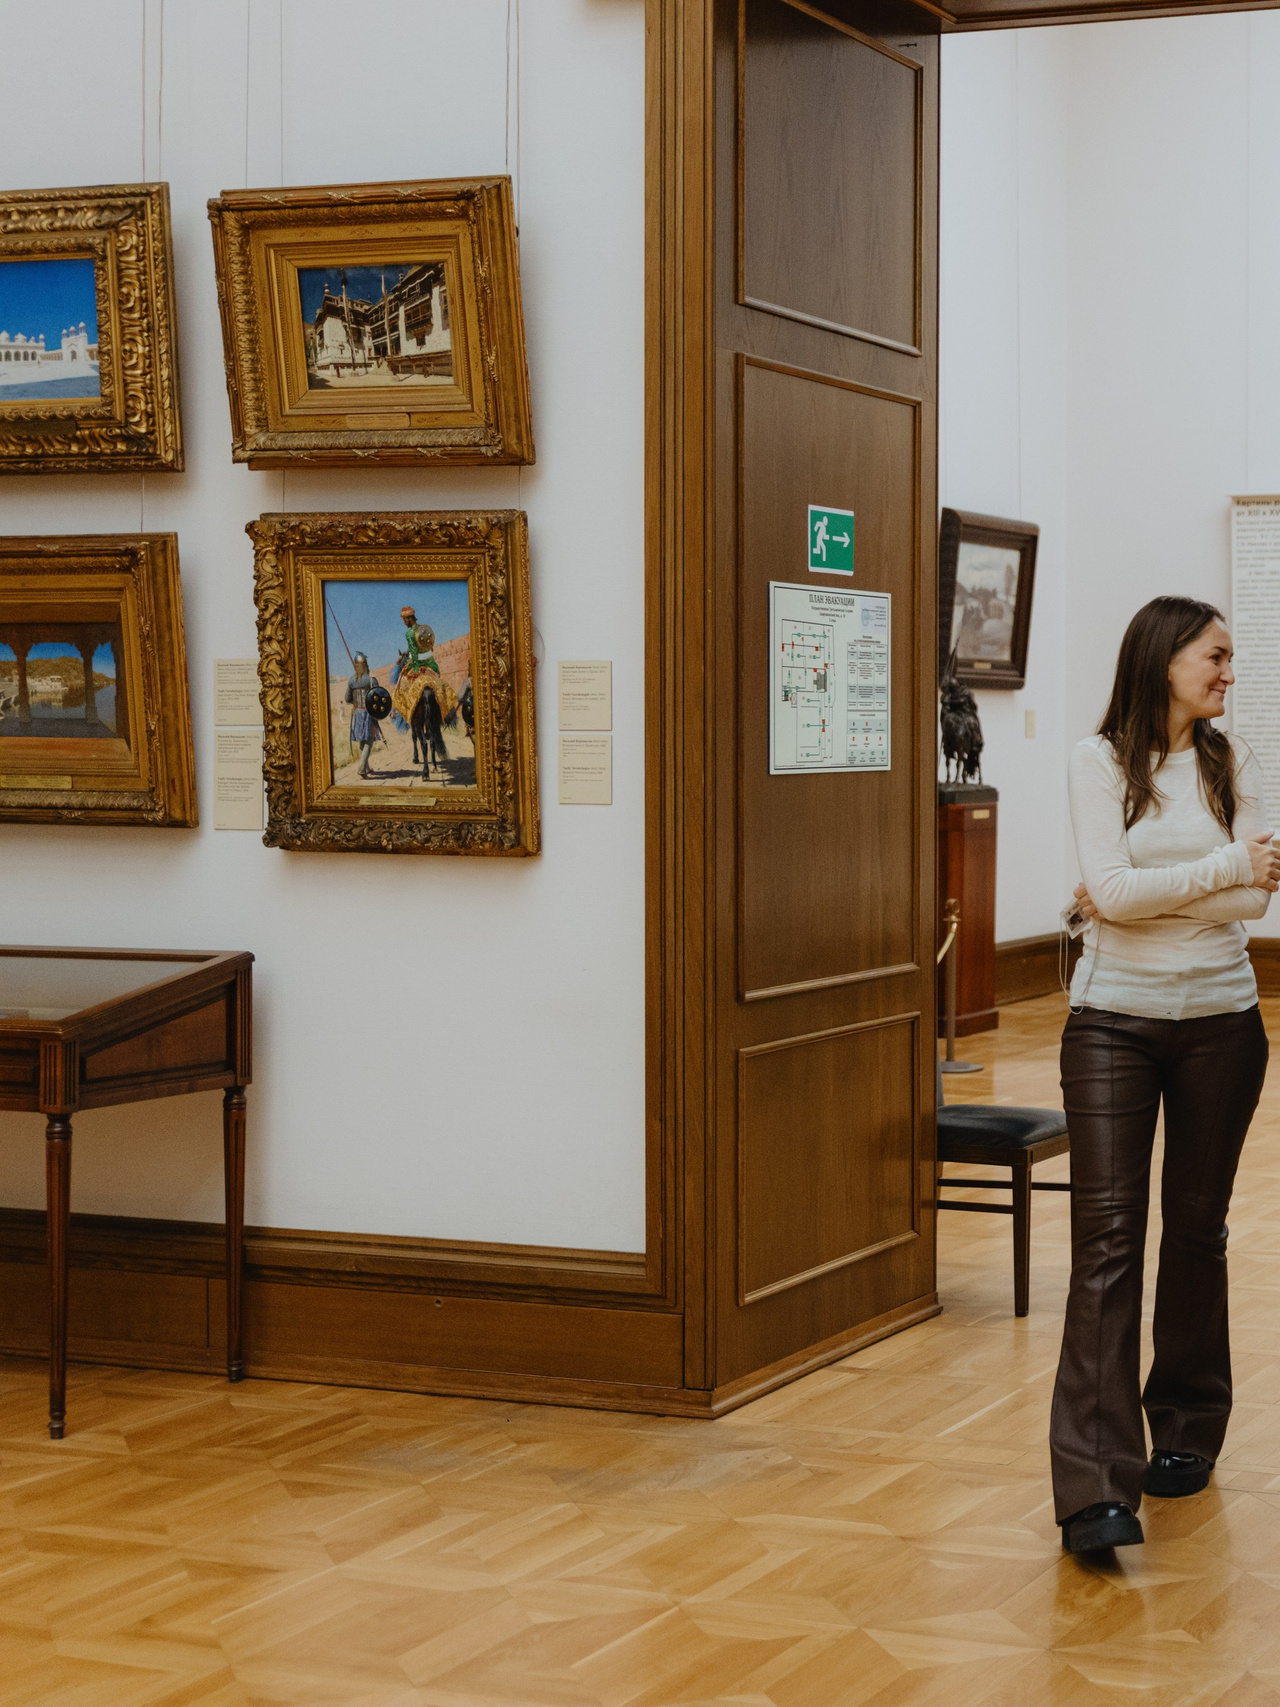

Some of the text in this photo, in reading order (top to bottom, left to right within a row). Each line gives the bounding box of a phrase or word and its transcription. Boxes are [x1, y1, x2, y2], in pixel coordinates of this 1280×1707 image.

[1236, 499, 1271, 507] Картины
[809, 594, 855, 607] ПЛАН ЭВАКУАЦИИ
